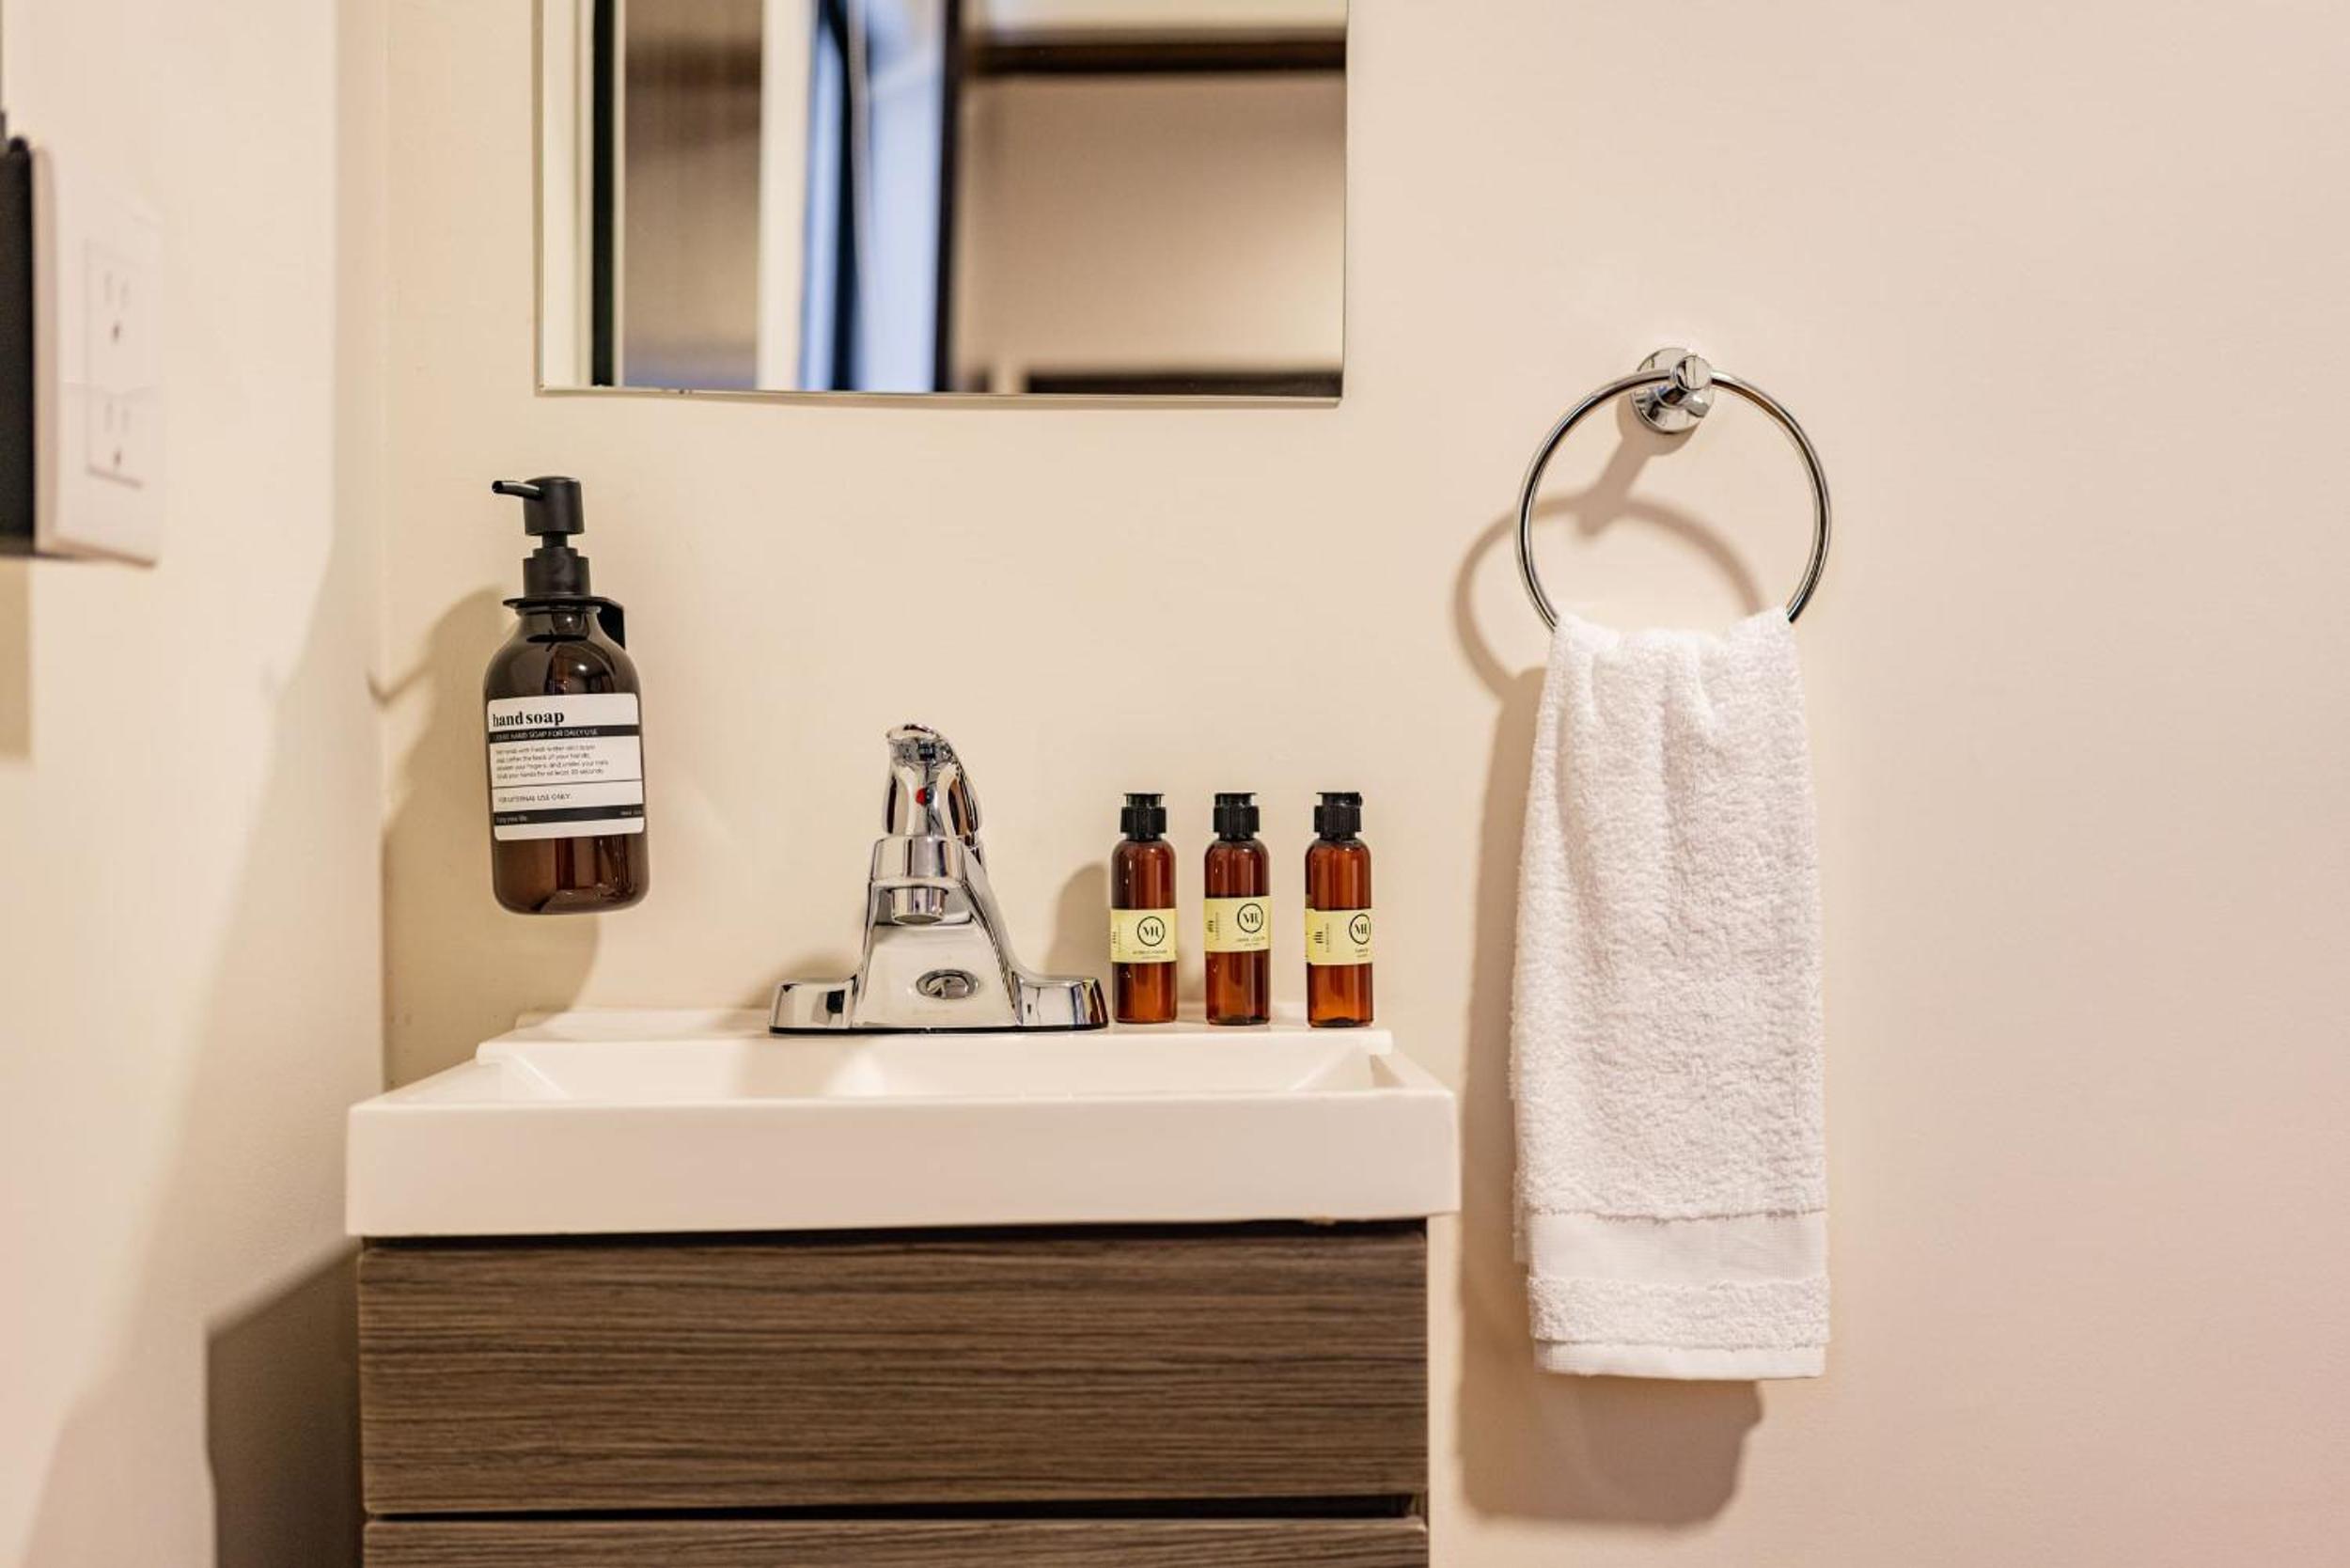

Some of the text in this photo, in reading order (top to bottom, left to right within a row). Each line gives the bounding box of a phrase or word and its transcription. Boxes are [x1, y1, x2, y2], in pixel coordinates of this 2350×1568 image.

[493, 711, 565, 728] hand soap
[529, 730, 547, 739] SOAP
[547, 729, 563, 738] FOR
